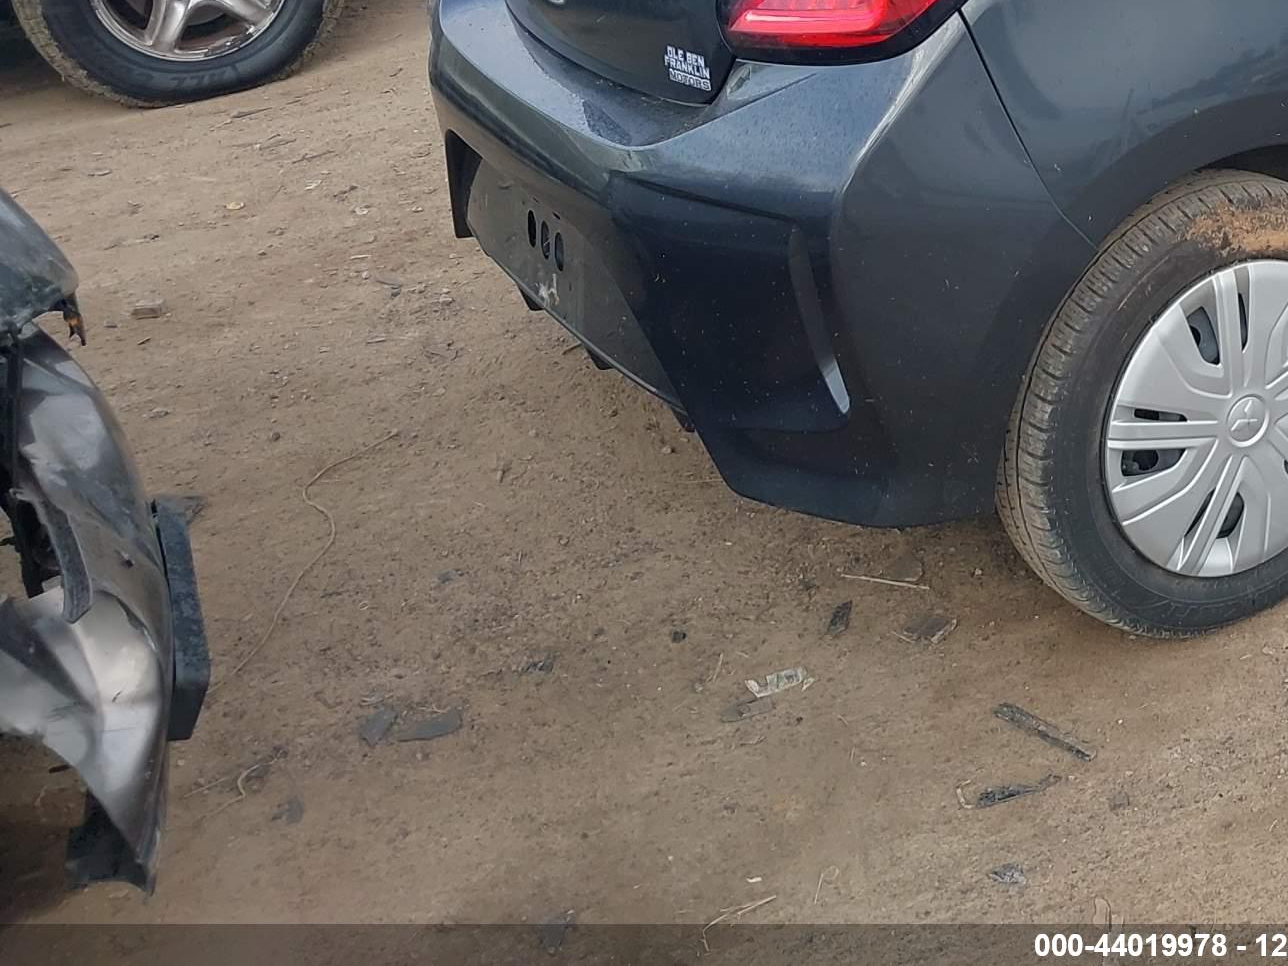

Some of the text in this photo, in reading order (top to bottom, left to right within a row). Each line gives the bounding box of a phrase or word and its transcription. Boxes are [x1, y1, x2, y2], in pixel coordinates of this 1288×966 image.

[664, 54, 710, 80] FRANKLIN
[666, 45, 705, 68] OLE BEN
[669, 68, 711, 91] MOTORS
